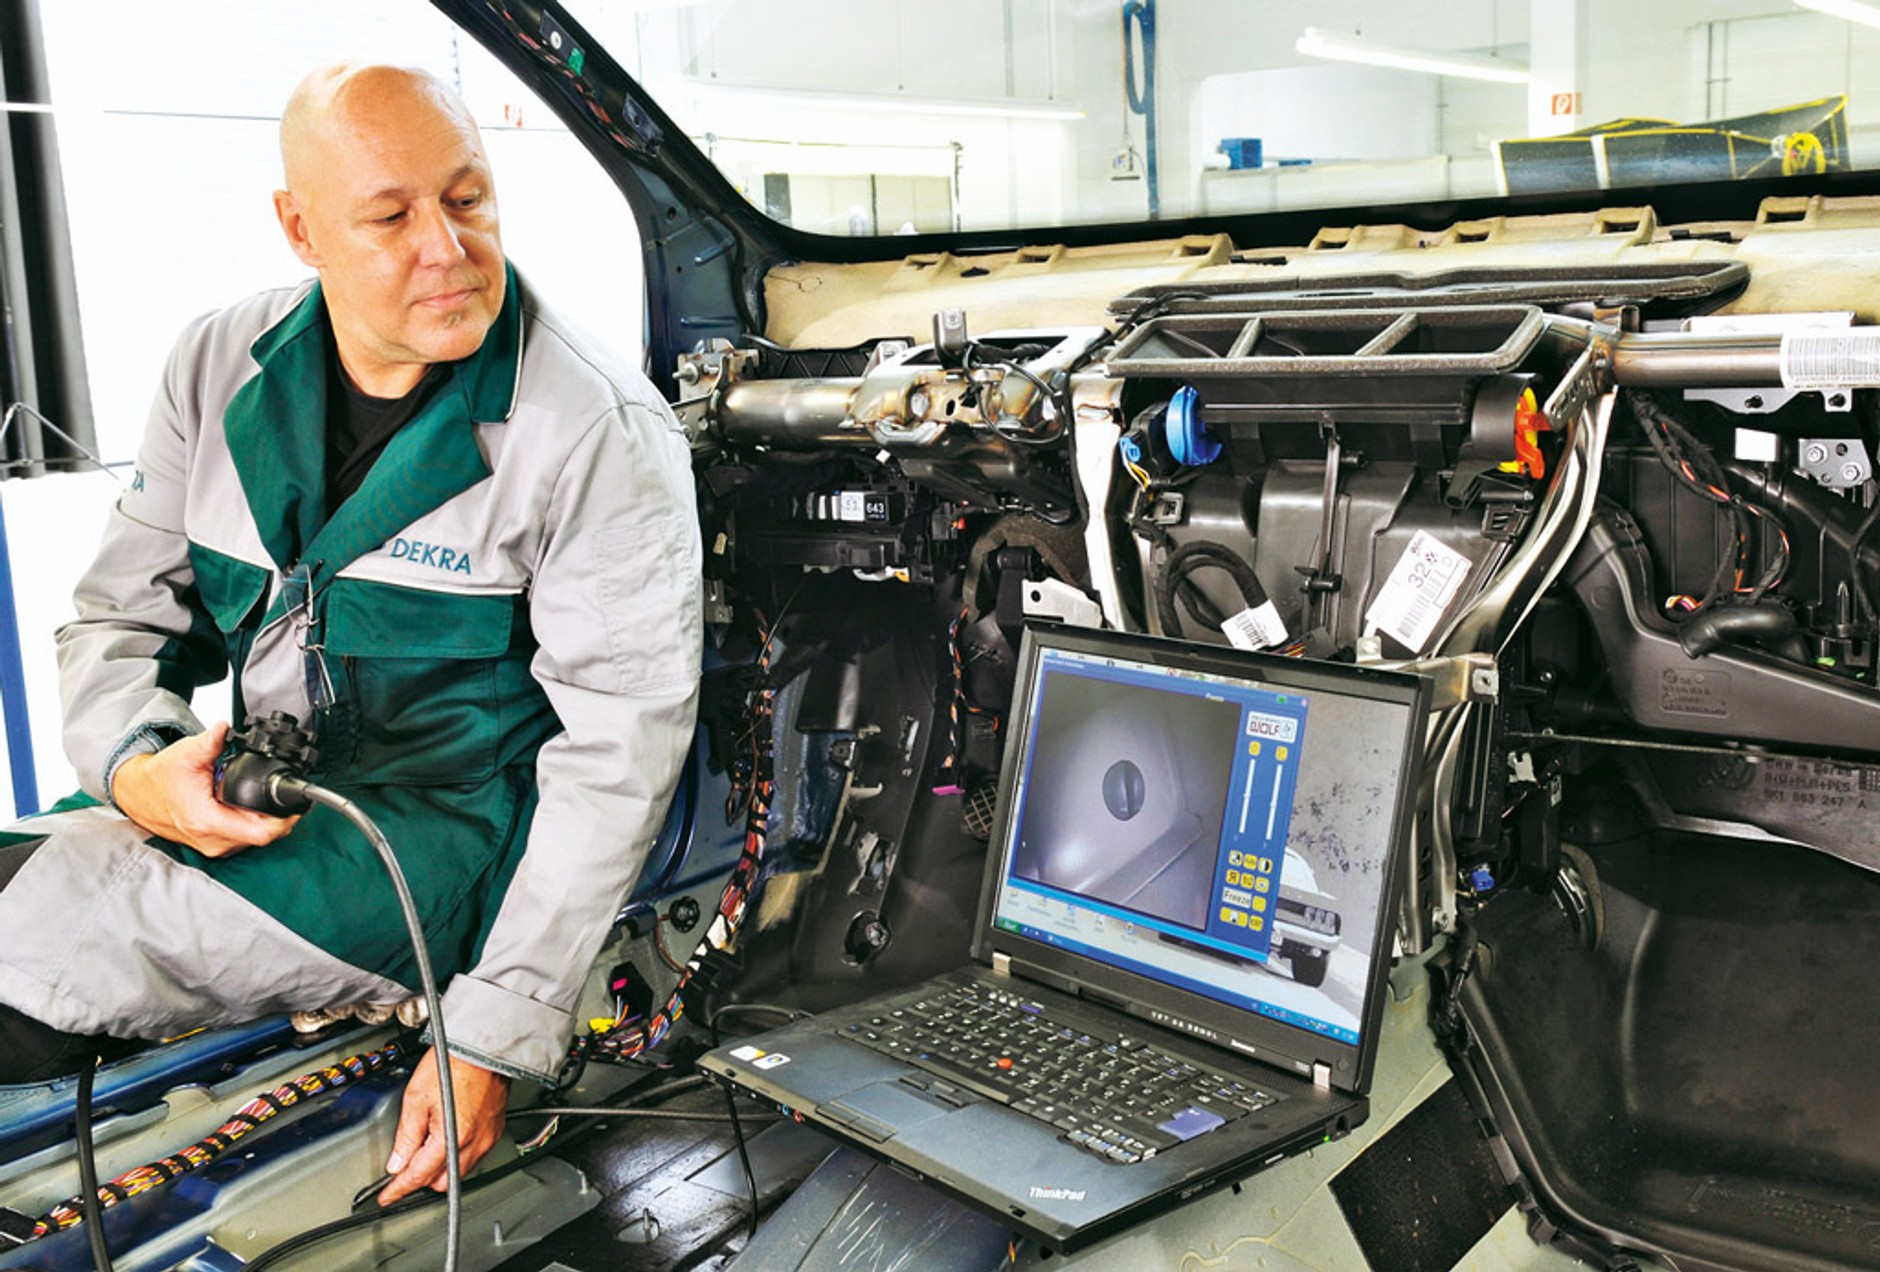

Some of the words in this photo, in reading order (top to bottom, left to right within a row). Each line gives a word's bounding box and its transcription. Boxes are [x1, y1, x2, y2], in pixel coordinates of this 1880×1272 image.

[866, 503, 884, 513] 643
[391, 538, 471, 575] DEKRA
[1408, 562, 1431, 589] 32
[1858, 799, 1867, 809] A
[1029, 1185, 1086, 1202] ThinkPad
